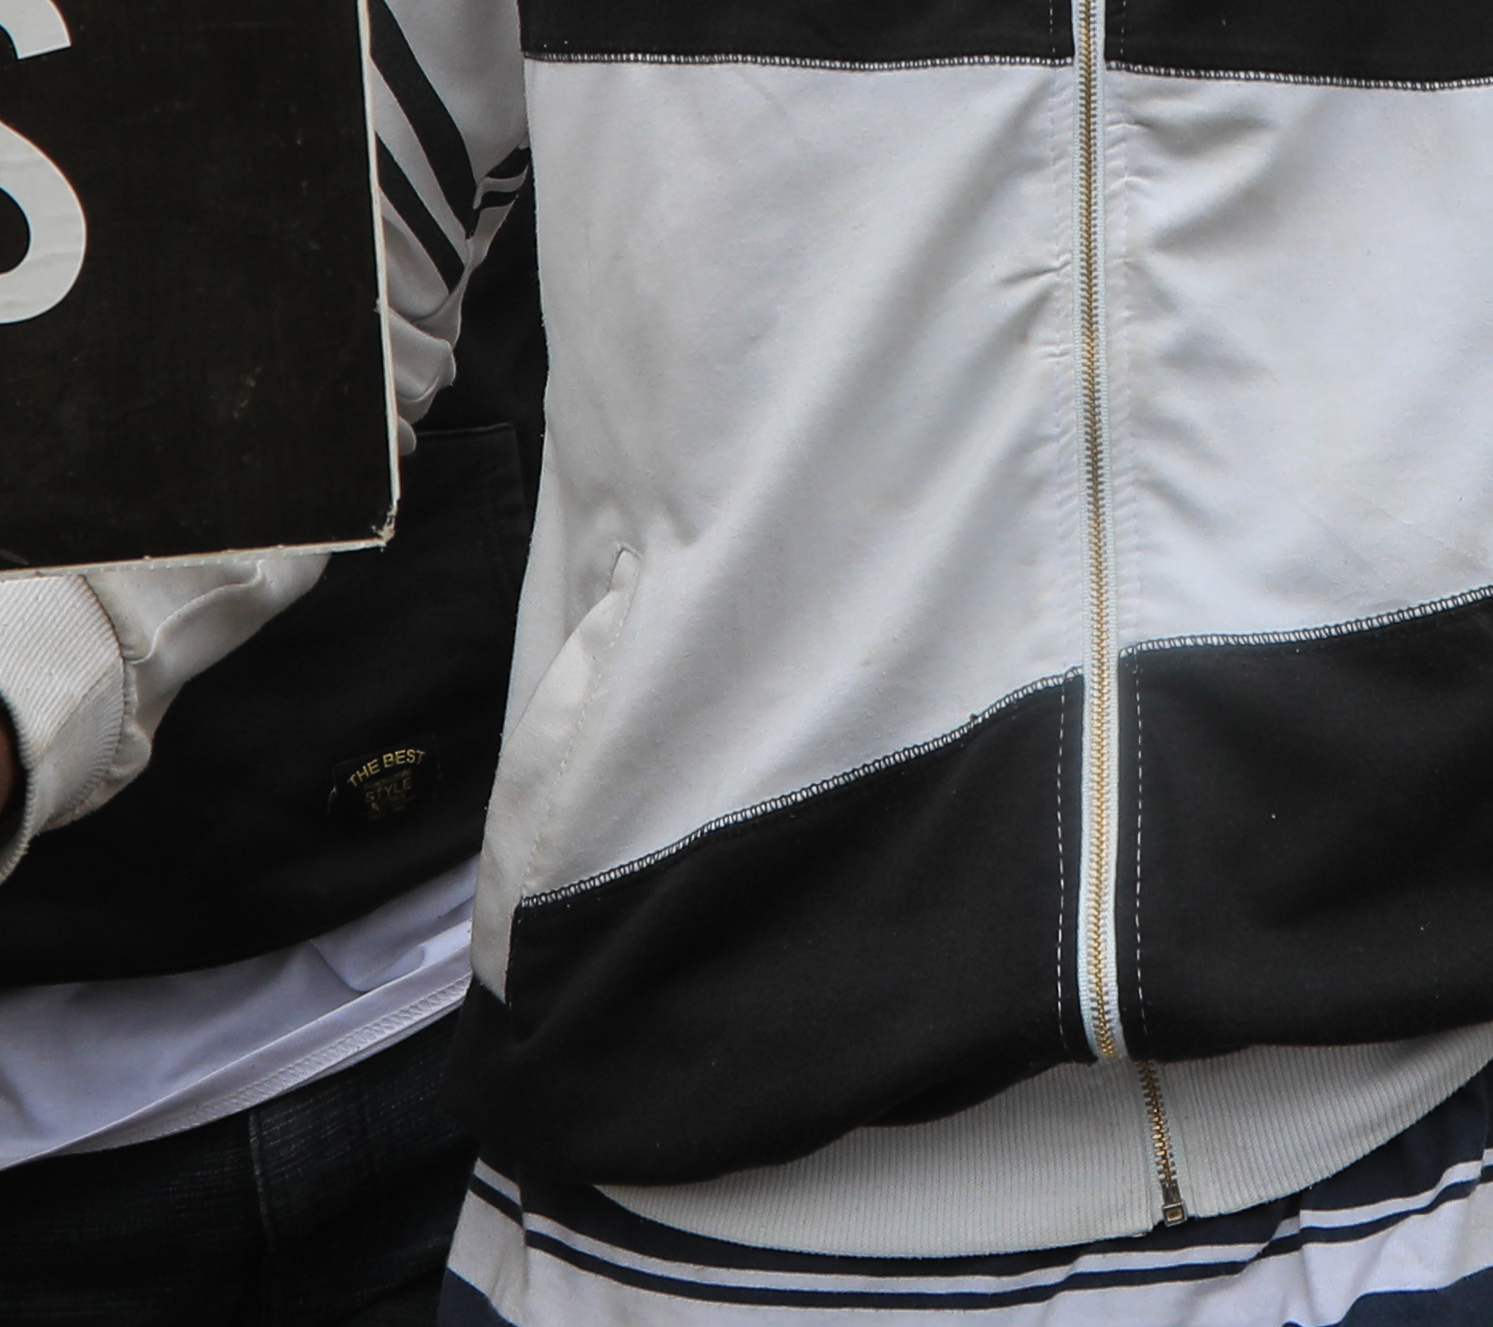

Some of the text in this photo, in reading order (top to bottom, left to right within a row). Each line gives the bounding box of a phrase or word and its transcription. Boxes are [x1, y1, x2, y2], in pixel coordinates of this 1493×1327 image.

[347, 757, 382, 788] THE
[382, 748, 426, 768] BEST
[365, 777, 412, 804] STYLE
